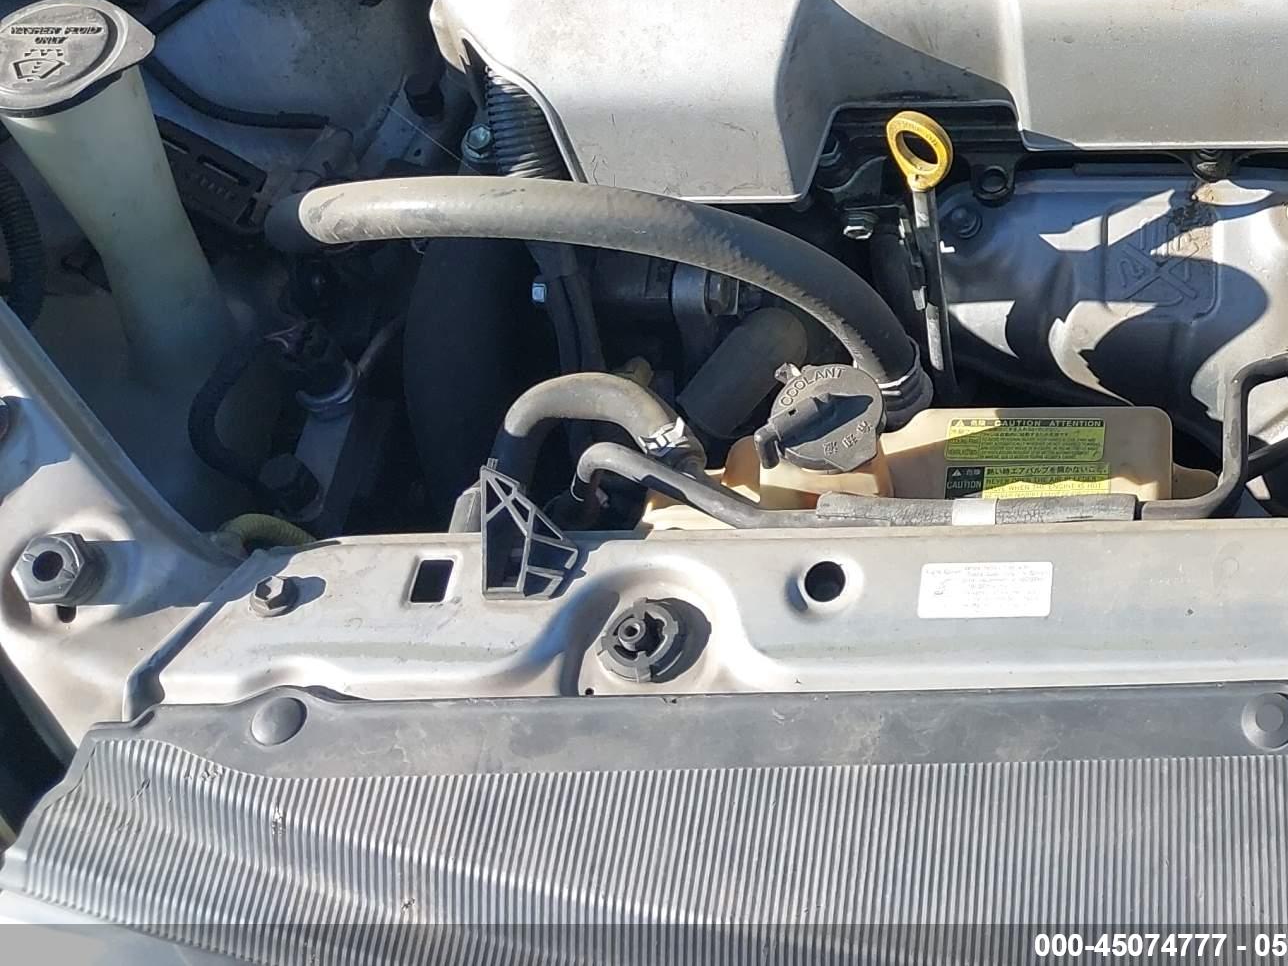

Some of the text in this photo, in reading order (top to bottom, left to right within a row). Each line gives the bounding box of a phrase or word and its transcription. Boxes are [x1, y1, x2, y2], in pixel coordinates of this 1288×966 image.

[781, 367, 846, 406] COOLANT
[1049, 419, 1101, 427] ATTENTION
[946, 481, 982, 490] CAUTION
